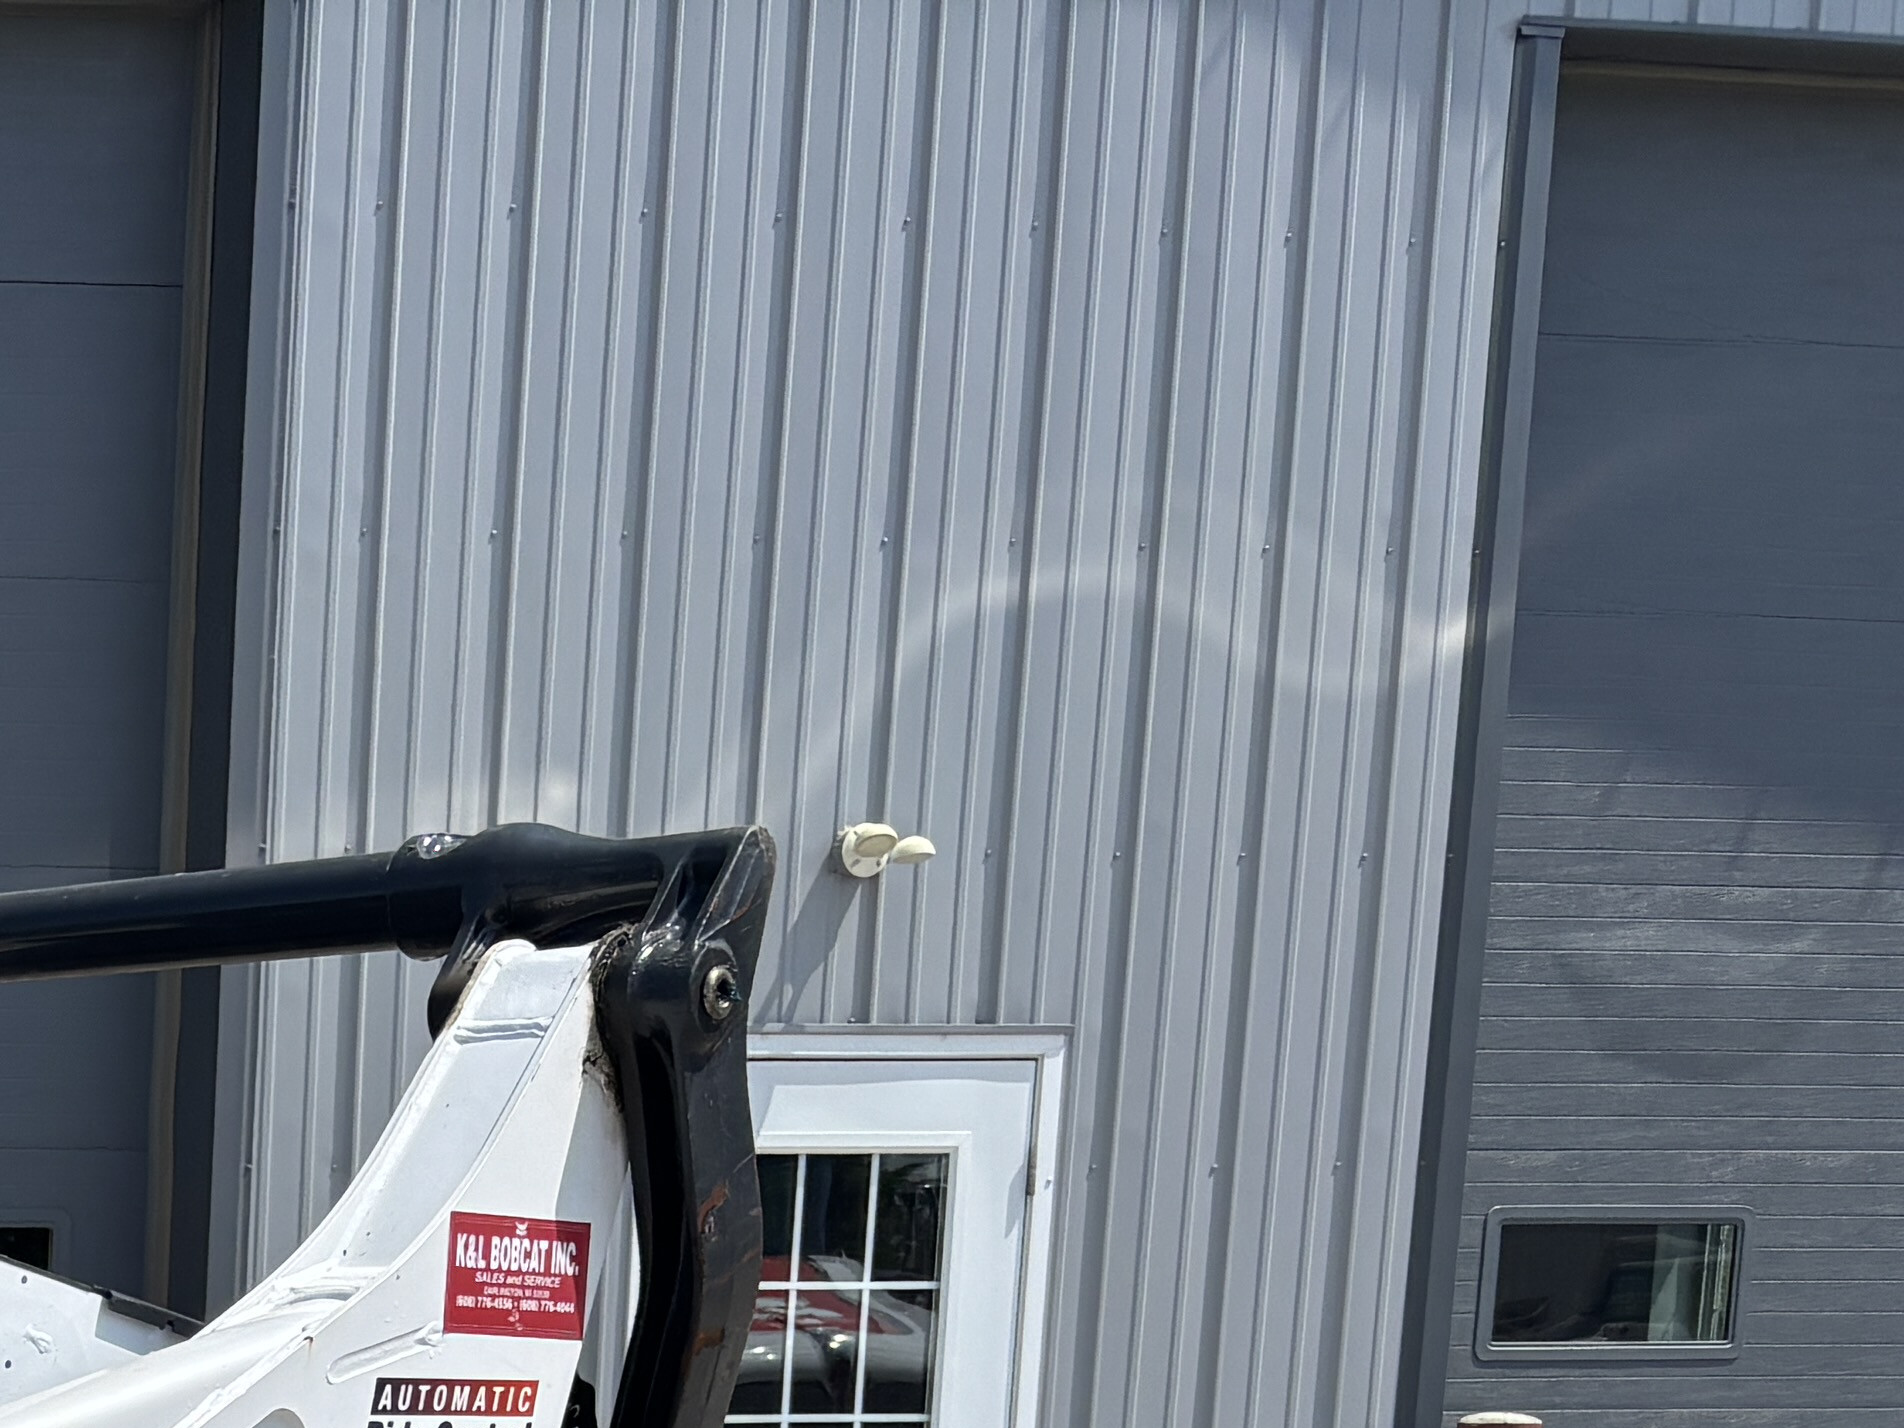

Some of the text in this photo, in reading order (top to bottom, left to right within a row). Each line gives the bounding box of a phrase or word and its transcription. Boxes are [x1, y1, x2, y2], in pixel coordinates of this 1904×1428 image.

[455, 1233, 579, 1276] K&L BOBCAT INC.
[475, 1271, 505, 1284] SALES
[523, 1275, 561, 1288] SERVICE
[377, 1384, 533, 1413] AUTOMATIC
